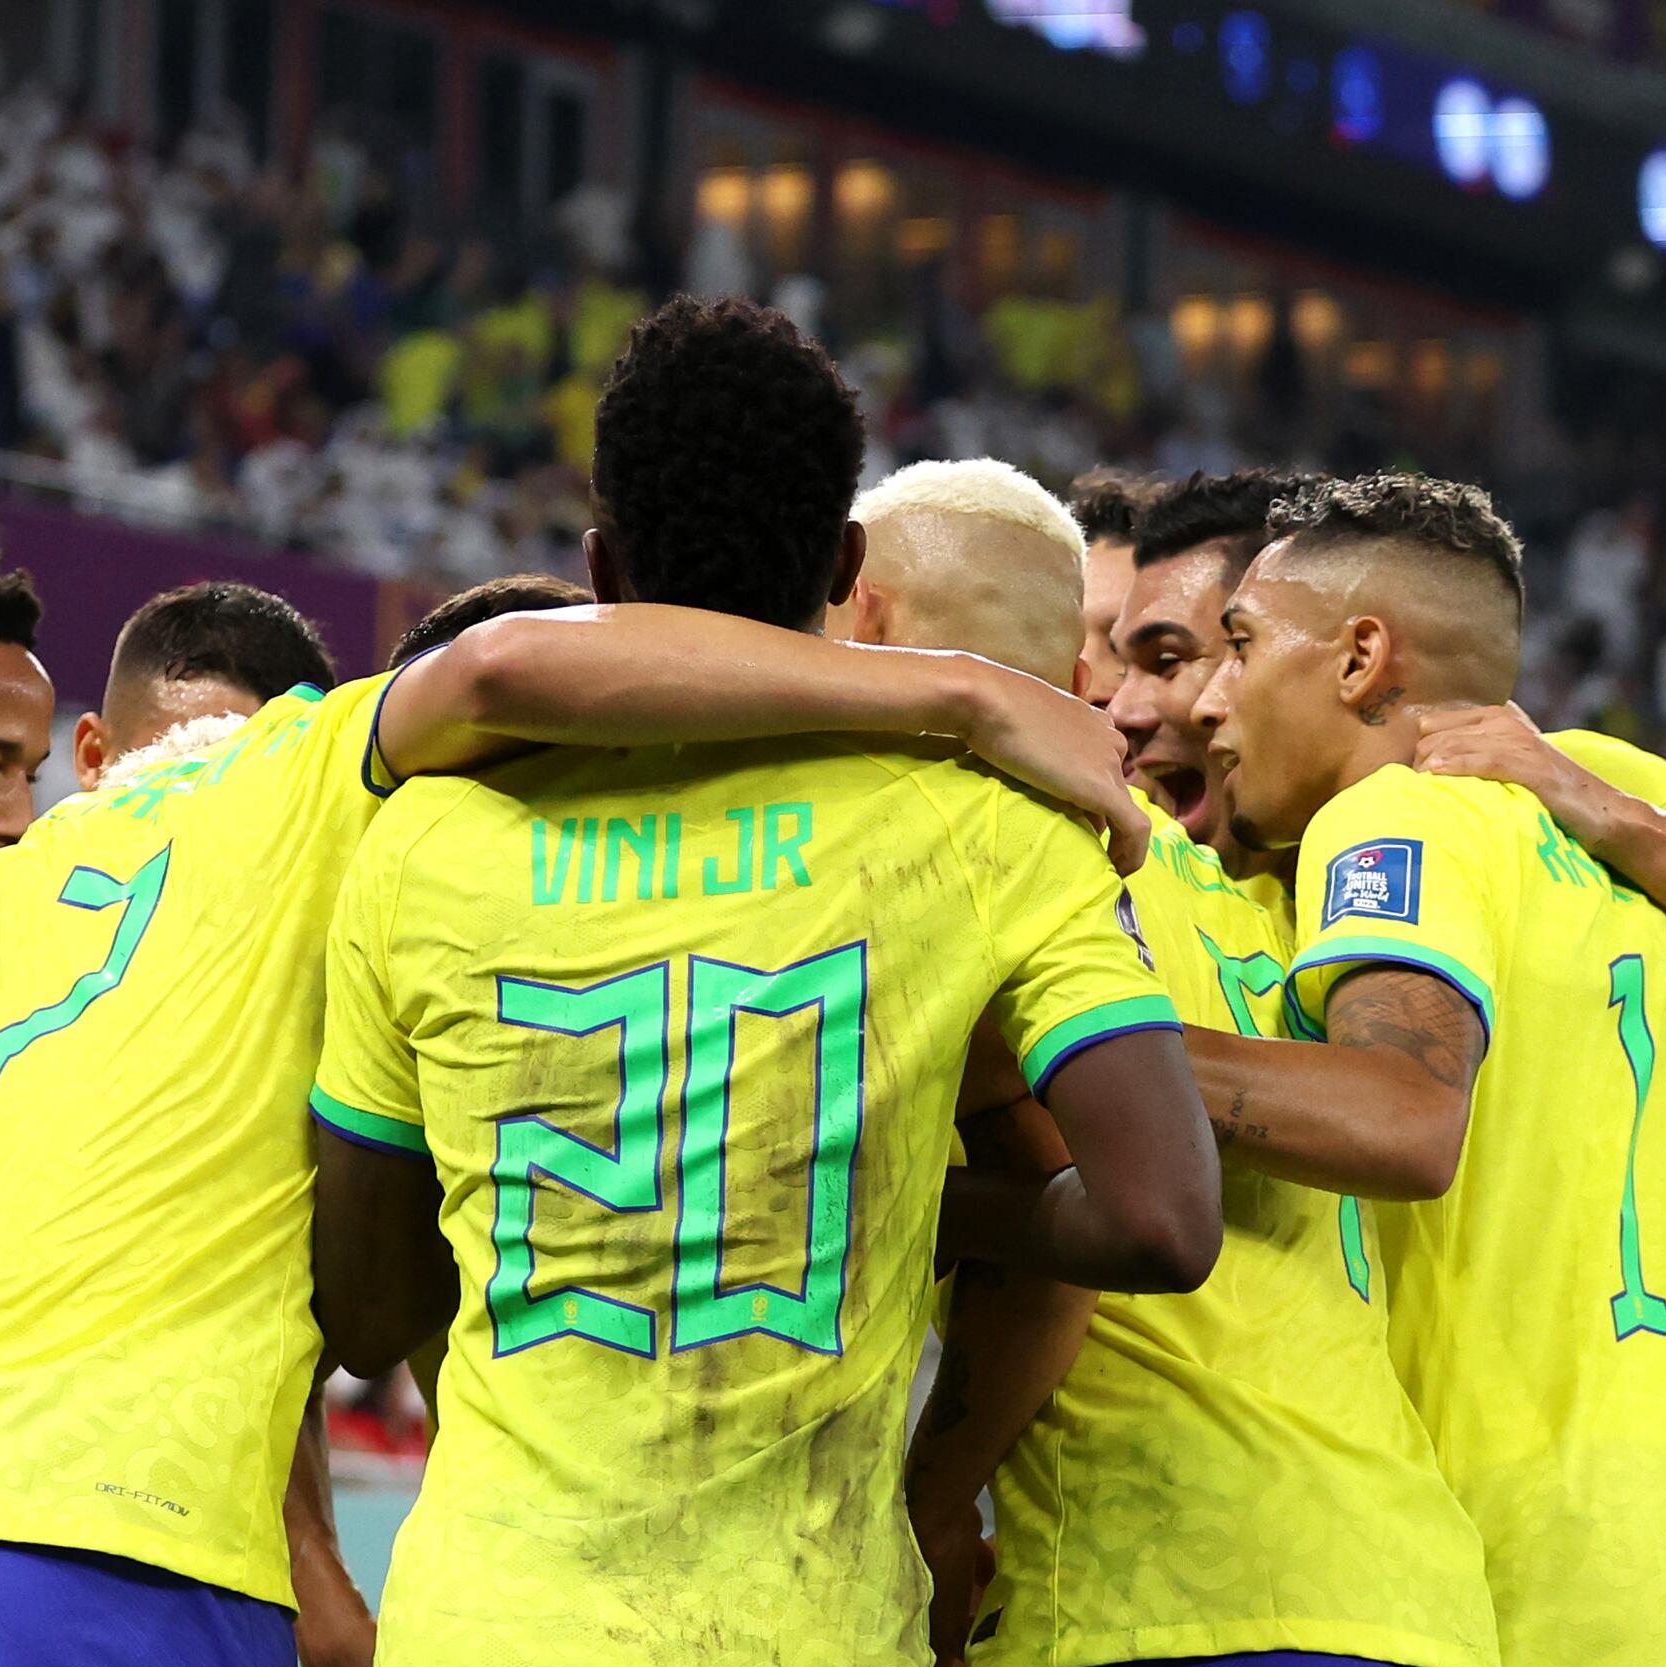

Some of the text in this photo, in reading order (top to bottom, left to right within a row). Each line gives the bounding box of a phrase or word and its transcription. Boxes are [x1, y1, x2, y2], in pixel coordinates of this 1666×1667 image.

[531, 801, 814, 905] VINI JR
[1346, 879, 1388, 892] UNITES
[491, 939, 868, 1360] 20
